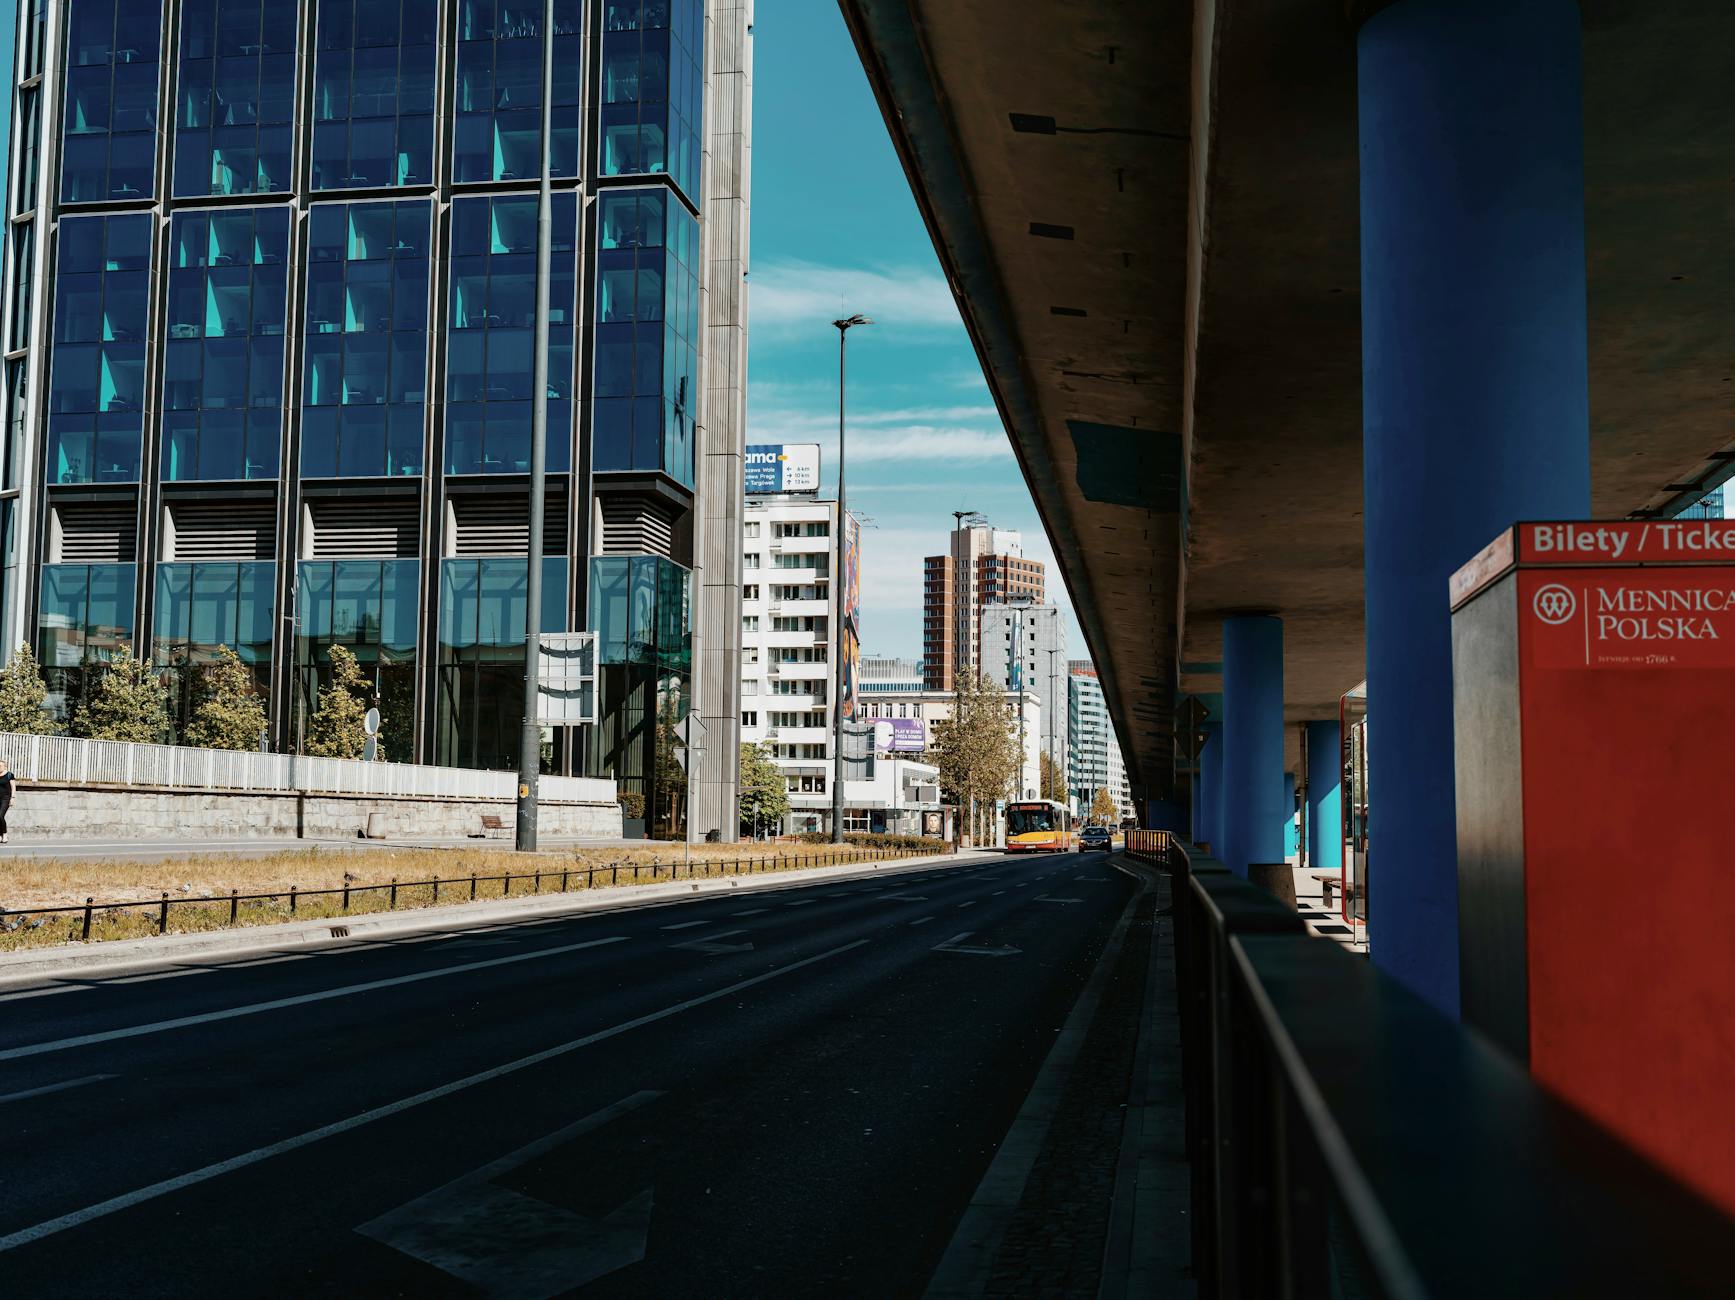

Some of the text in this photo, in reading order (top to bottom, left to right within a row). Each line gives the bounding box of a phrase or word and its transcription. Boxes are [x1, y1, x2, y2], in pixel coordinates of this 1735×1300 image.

[1534, 525, 1629, 558] Bilety
[1638, 524, 1650, 552] /
[1597, 615, 1720, 640] POLSKA
